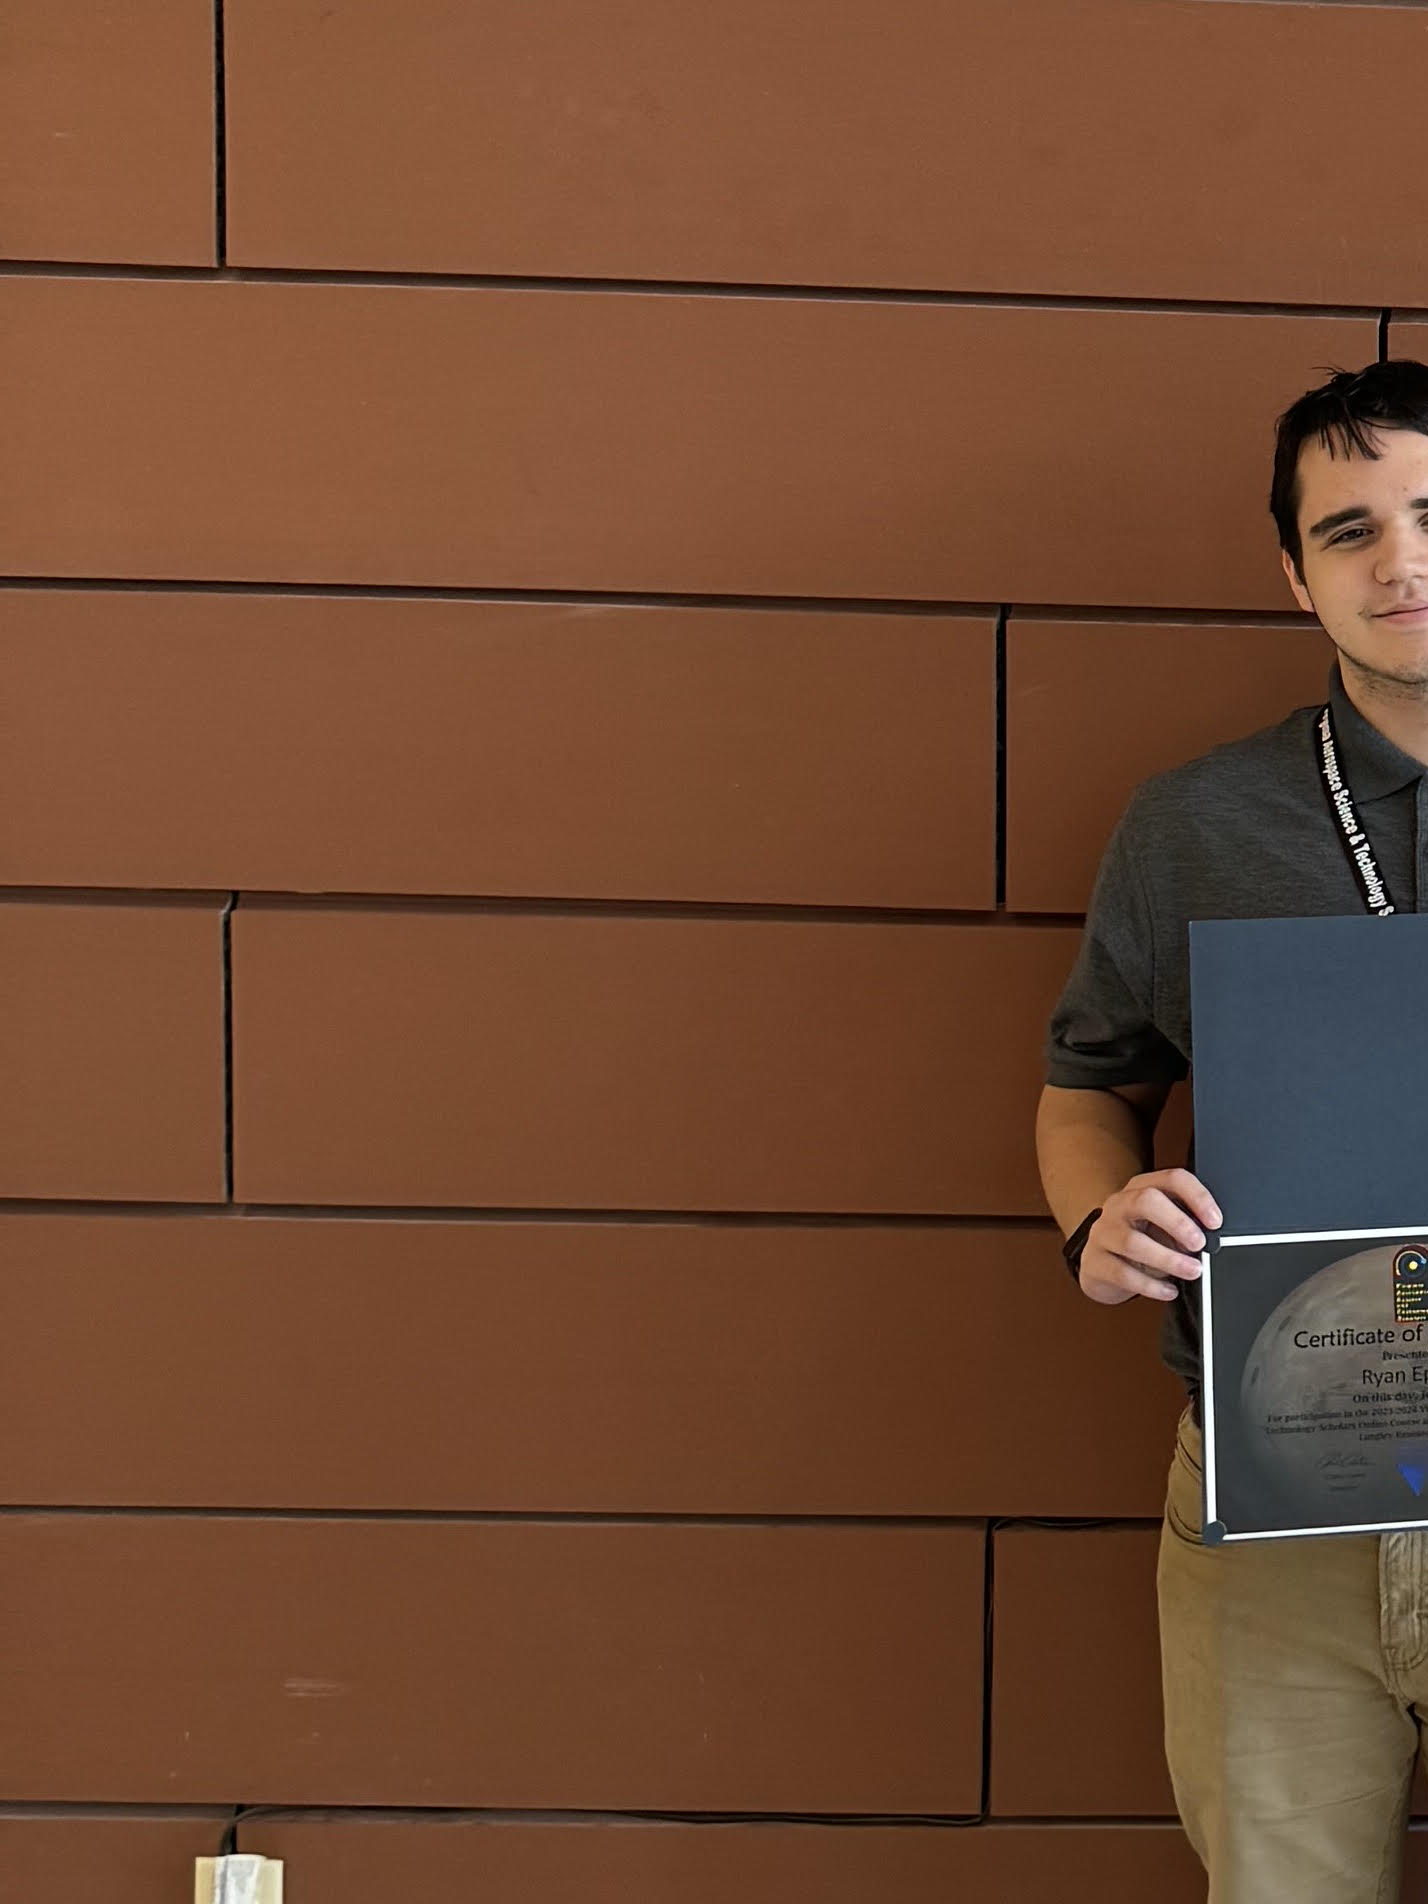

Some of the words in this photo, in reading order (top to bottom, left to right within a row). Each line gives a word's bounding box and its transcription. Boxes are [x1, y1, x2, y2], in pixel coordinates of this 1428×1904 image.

[1353, 842, 1388, 908] Technology
[1293, 1327, 1396, 1349] Certificate
[1402, 1323, 1424, 1343] of
[1362, 1369, 1407, 1388] Ryan
[1353, 1393, 1369, 1403] On
[1370, 1392, 1392, 1402] this
